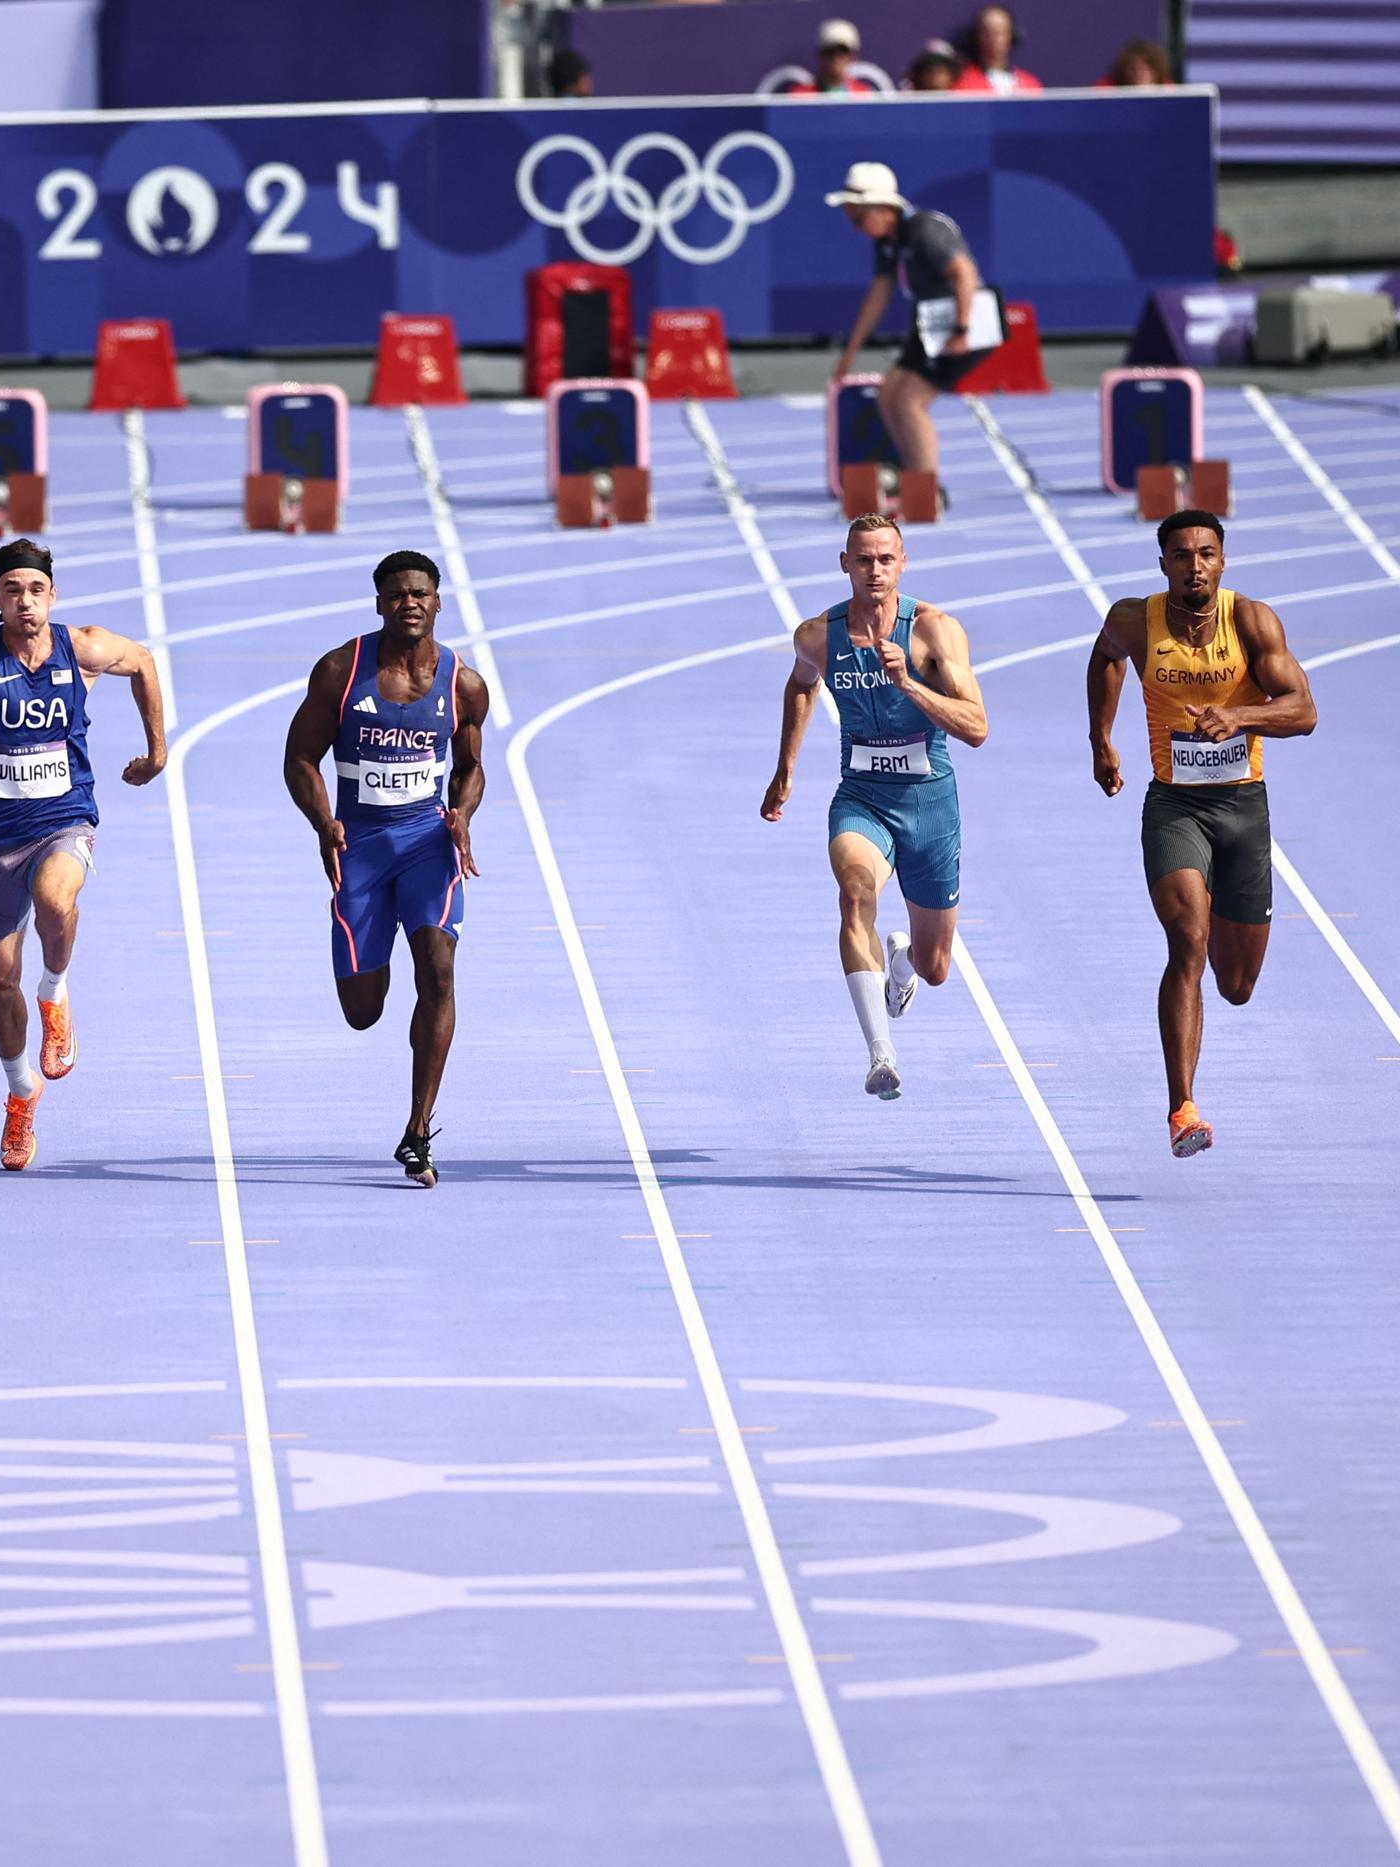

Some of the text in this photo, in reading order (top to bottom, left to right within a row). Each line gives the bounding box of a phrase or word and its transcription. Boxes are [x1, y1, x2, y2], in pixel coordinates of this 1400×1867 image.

[36, 160, 399, 262] 2024
[833, 669, 894, 689] ESTONI
[1155, 666, 1237, 685] GERMANY
[1, 697, 68, 729] USA
[359, 726, 438, 750] FRANCE
[871, 754, 910, 773] ERM
[1173, 743, 1248, 767] NEUGEBAUER
[365, 768, 431, 789] GLETTY
